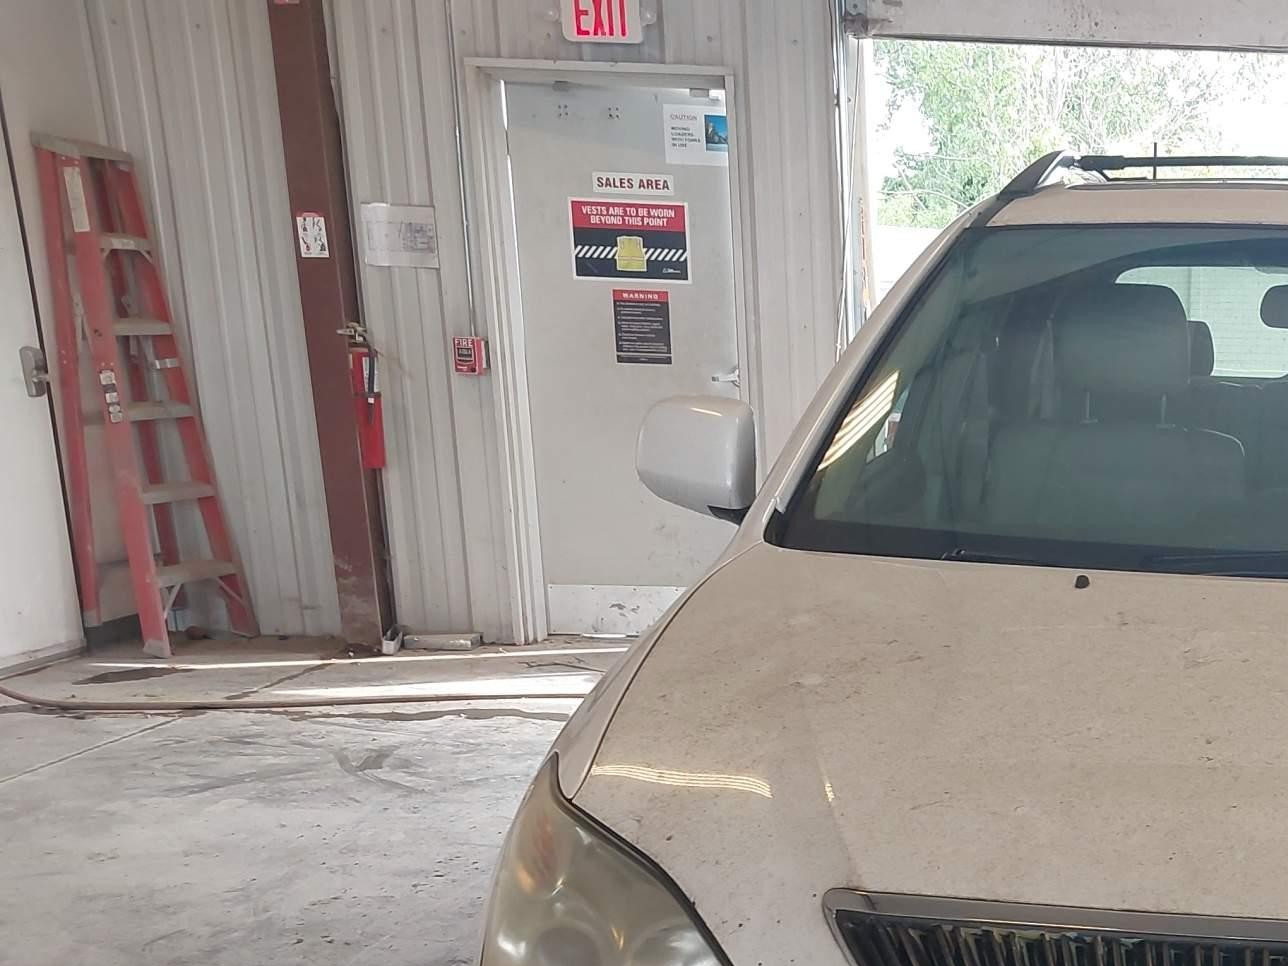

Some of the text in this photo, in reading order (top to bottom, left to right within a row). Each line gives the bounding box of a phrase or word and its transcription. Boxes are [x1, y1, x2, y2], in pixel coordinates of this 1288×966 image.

[596, 176, 670, 191] SALES AREA
[581, 205, 675, 218] VESTS ARE TO BE WORN
[590, 215, 668, 227] BEYOND THIS POINT
[622, 292, 659, 300] WARNING
[455, 338, 473, 347] FIRE
